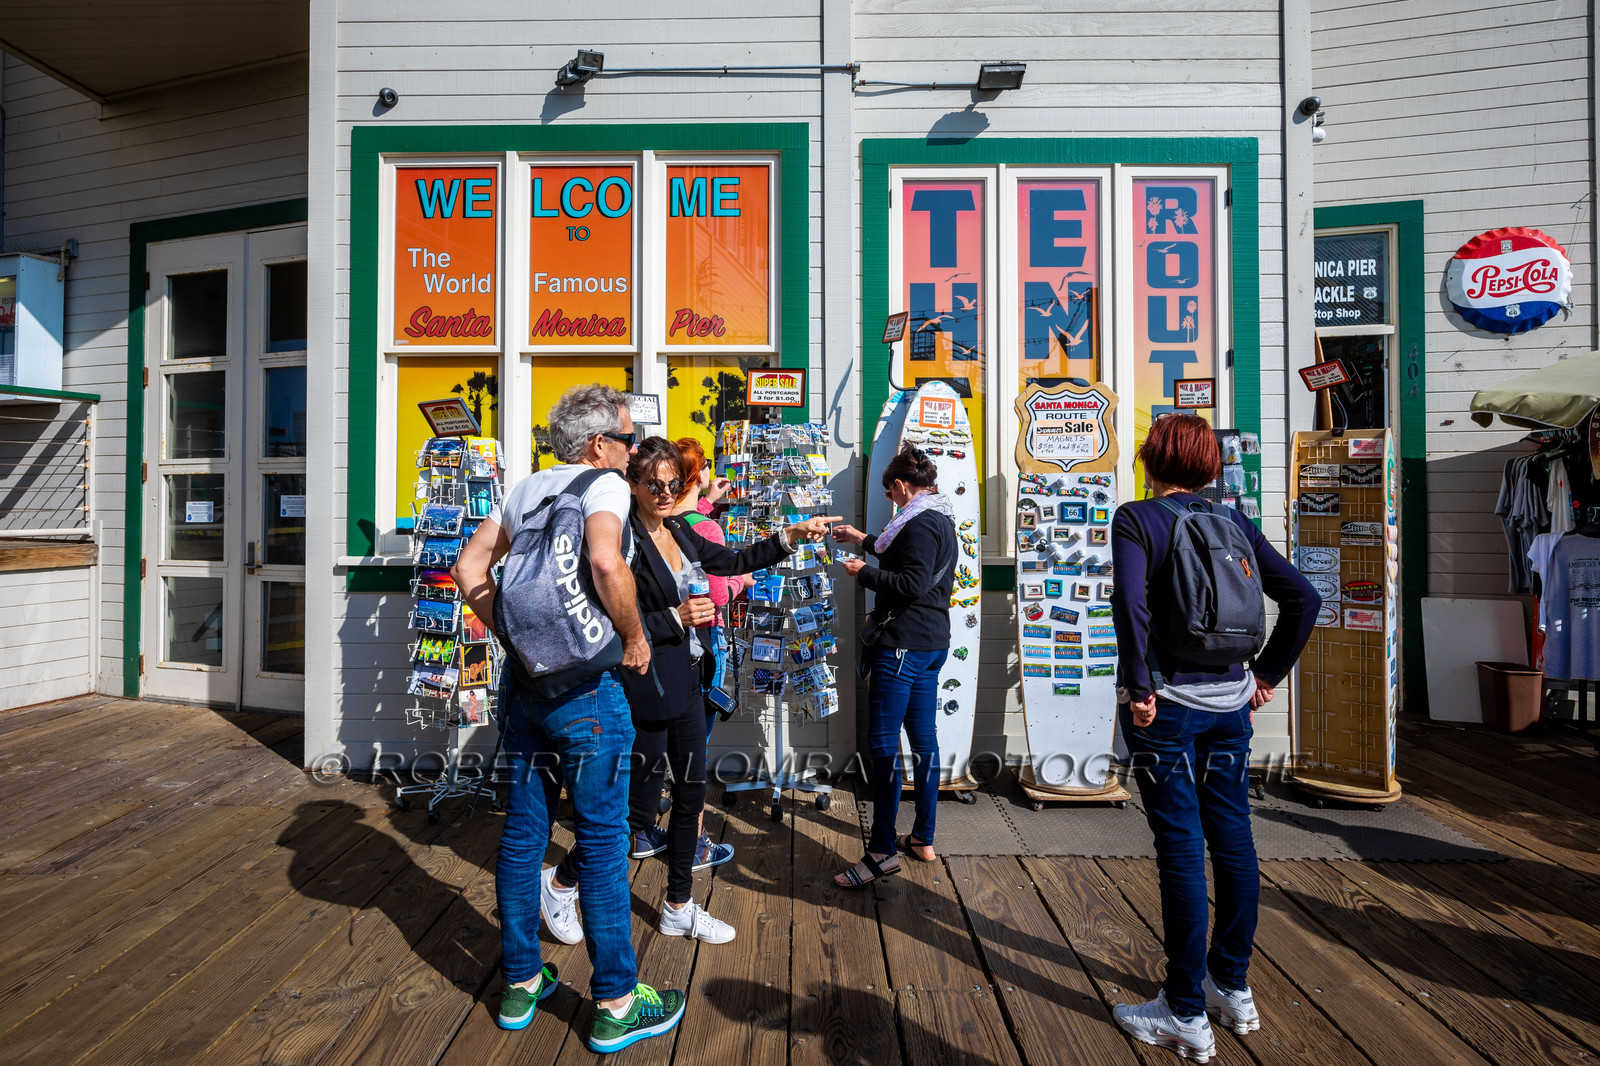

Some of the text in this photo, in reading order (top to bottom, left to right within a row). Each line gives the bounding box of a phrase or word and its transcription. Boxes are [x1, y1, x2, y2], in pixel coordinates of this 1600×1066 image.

[566, 226, 590, 242] TO
[407, 247, 452, 268] The
[1348, 259, 1377, 276] PIER
[423, 273, 628, 294] World Famous
[1314, 285, 1355, 303] ACKLE
[1336, 308, 1361, 320] Shop
[404, 306, 727, 338] Santa Monica Pier
[1320, 364, 1338, 375] MATCH
[754, 374, 798, 389] SUPER SALE
[1194, 383, 1211, 392] MATCH
[1034, 401, 1099, 410] SANTA MONICA
[430, 407, 450, 421] SUPER
[1045, 412, 1087, 420] ROUTE
[1064, 421, 1094, 433] Sale
[1068, 508, 1078, 517] 66
[554, 534, 604, 644] adidas
